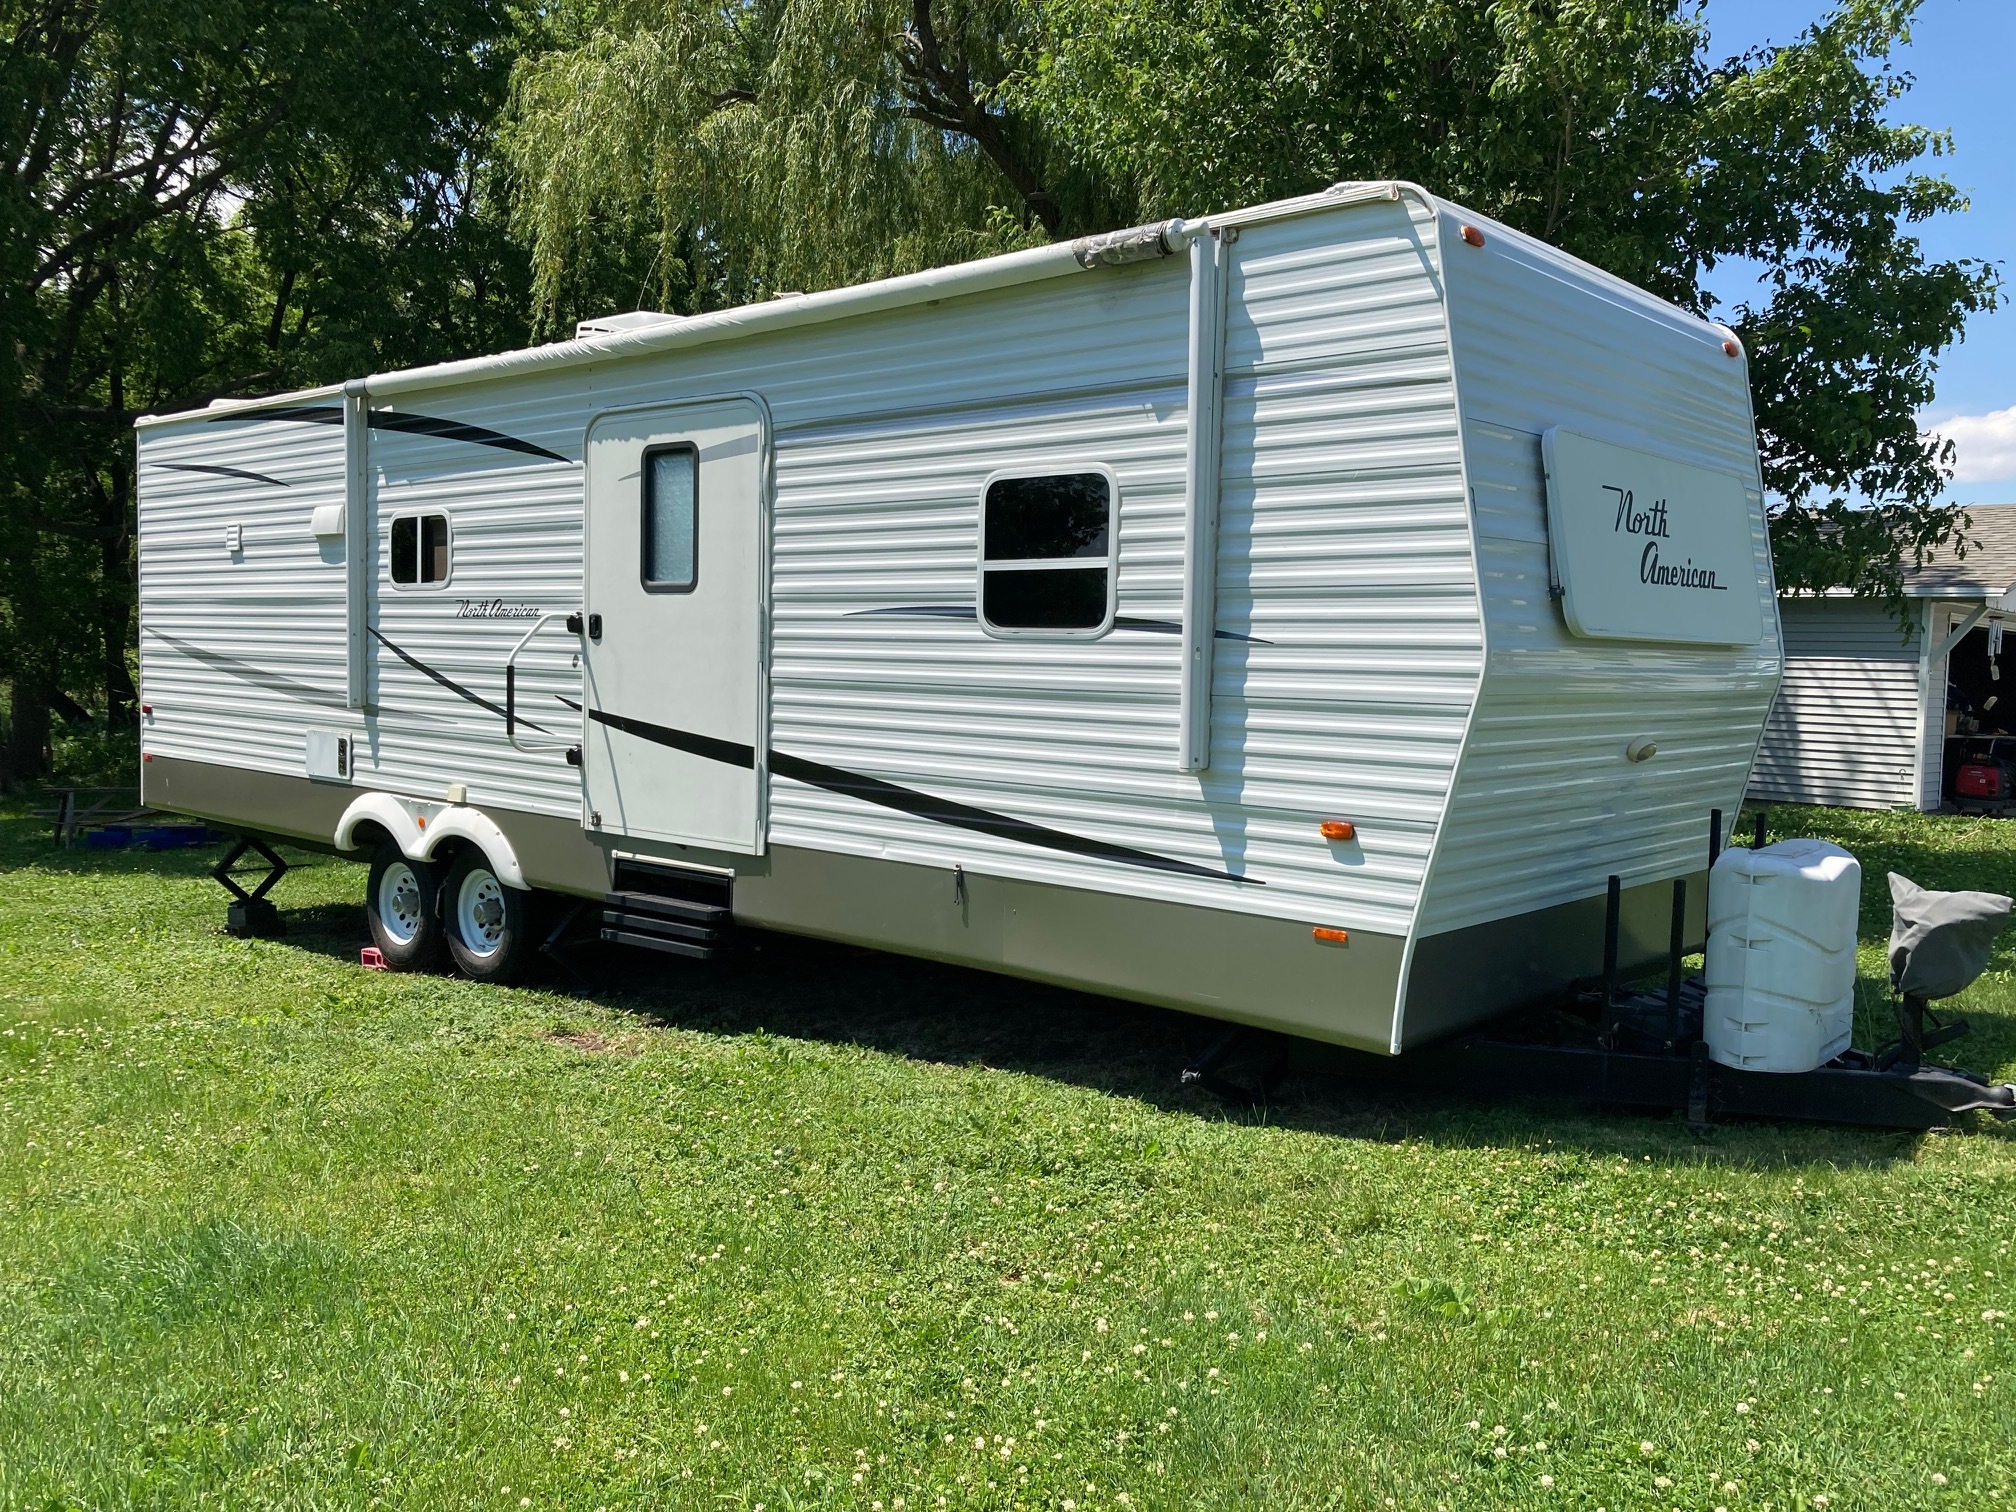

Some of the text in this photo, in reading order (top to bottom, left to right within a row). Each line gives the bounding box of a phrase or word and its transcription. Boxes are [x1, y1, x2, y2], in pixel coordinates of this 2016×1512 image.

[1602, 485, 1670, 538] North
[1640, 541, 1728, 591] American
[455, 598, 541, 618] North American
